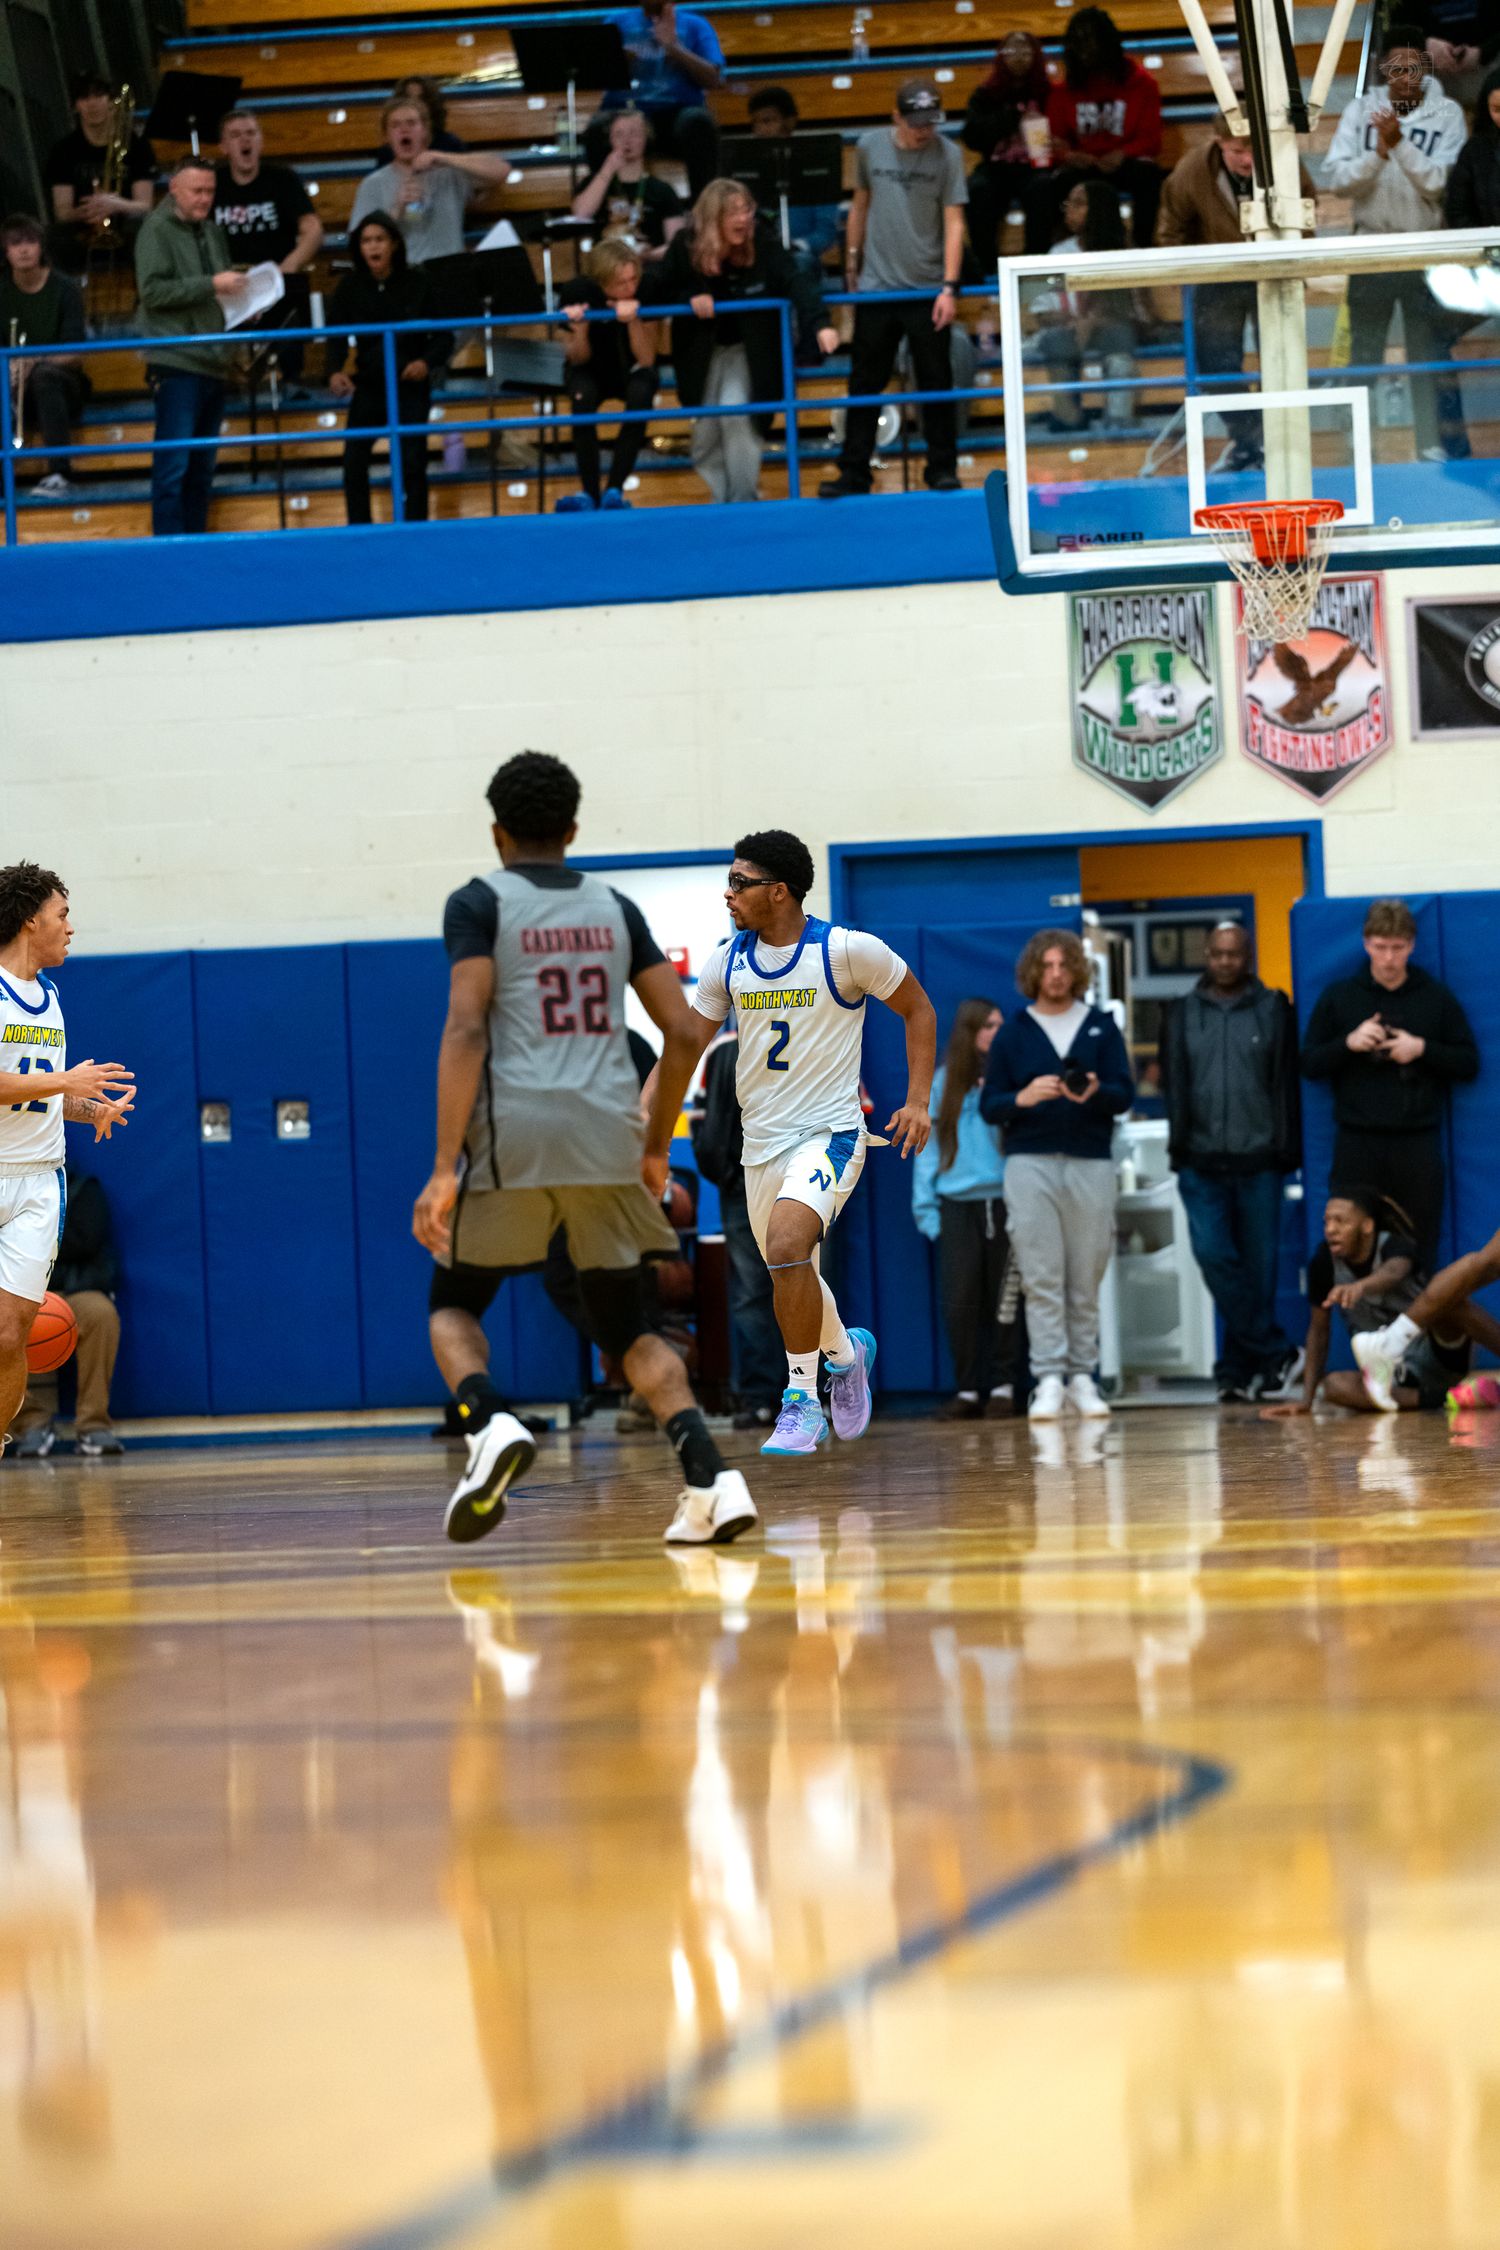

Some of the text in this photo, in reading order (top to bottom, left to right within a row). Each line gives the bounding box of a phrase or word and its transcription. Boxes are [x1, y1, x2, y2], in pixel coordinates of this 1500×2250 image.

[215, 202, 278, 226] HOPE
[1079, 531, 1145, 545] GARED
[1077, 592, 1211, 681] HARRISON
[1081, 706, 1213, 783] WILDCATS
[1248, 691, 1383, 771] FIGHTING OWLS
[521, 926, 615, 955] CARDINALS
[537, 963, 611, 1035] 22
[740, 987, 817, 1010] NORTHWEST
[2, 1023, 65, 1048] NORTHWEST
[766, 1019, 791, 1071] 2
